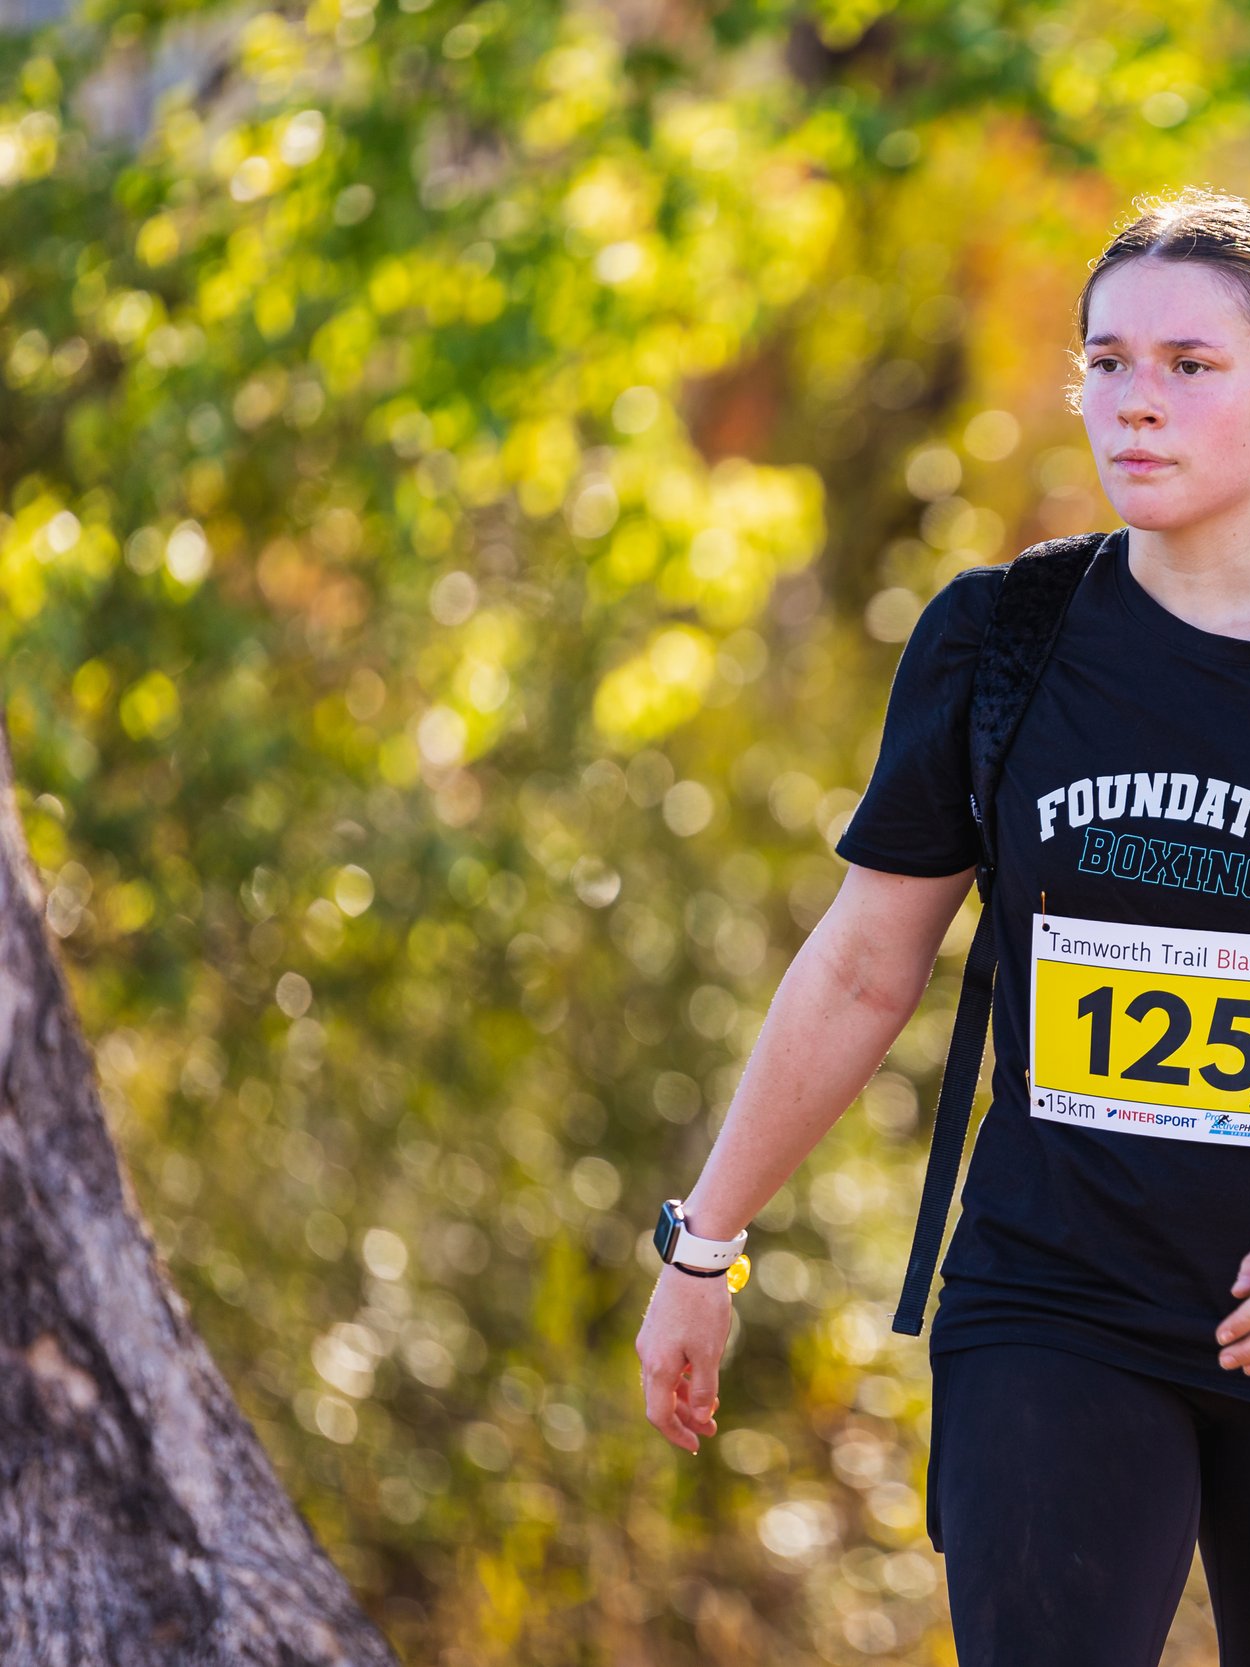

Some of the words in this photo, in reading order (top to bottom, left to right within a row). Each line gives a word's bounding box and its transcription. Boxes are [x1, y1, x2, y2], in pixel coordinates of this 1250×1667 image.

[1049, 931, 1151, 963] Tamworth
[1161, 944, 1208, 968] Trail
[1045, 1093, 1095, 1119] 15km
[1118, 1109, 1198, 1129] INTERSPORT
